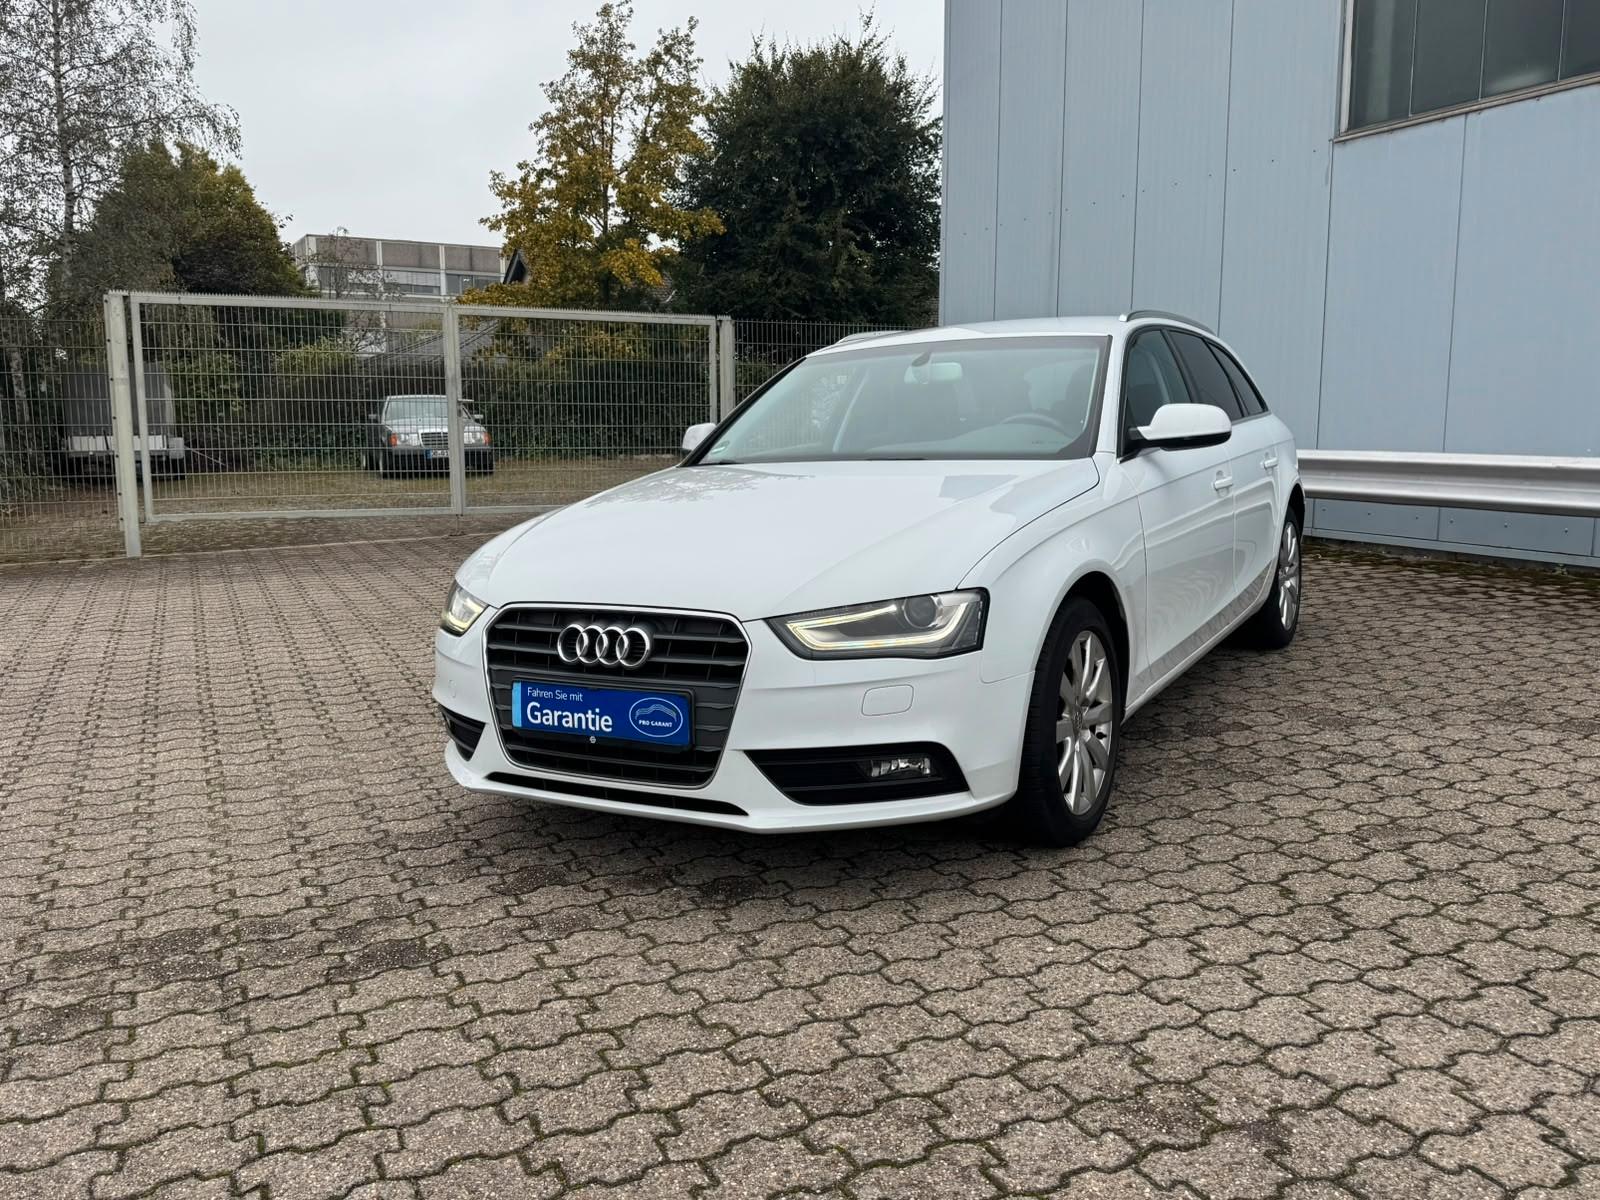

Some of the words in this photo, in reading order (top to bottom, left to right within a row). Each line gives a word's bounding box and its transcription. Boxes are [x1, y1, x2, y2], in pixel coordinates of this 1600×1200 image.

[527, 686, 553, 699] Fahren
[555, 689, 568, 701] Sie
[569, 691, 584, 703] mit
[527, 701, 613, 732] Garantie
